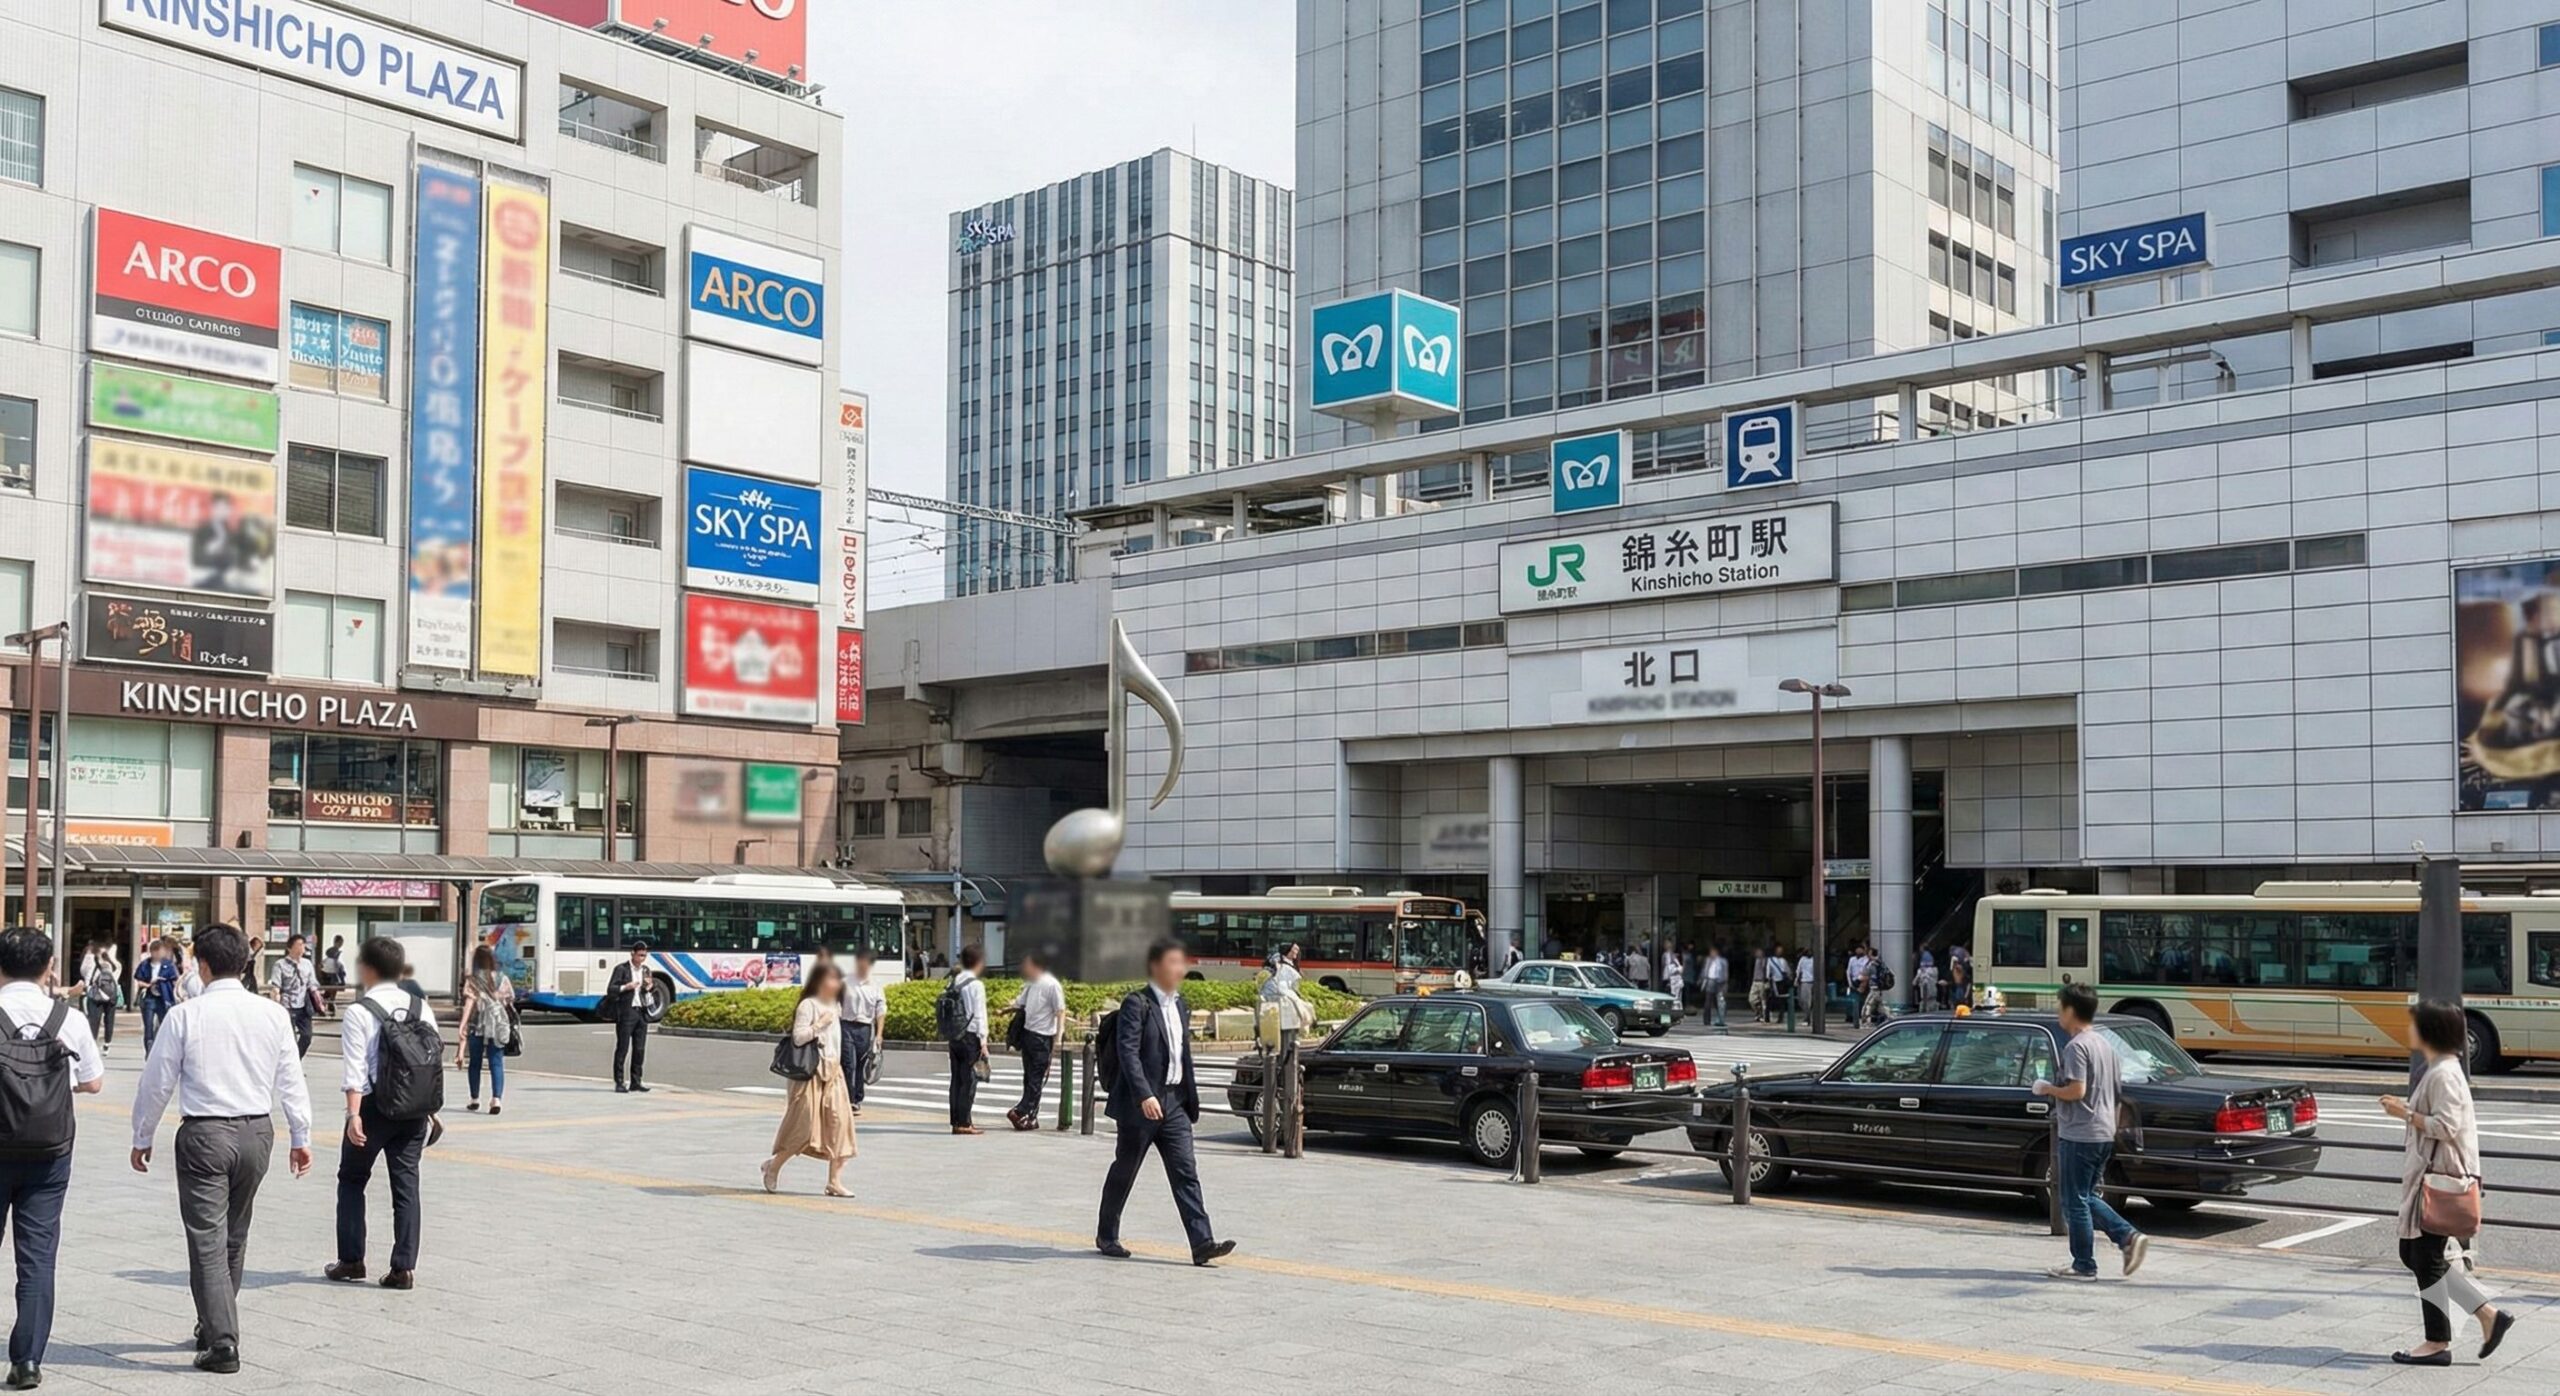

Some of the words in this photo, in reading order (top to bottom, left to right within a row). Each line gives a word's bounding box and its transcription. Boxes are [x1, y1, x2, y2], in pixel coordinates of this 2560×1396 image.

[379, 42, 505, 120] PLAZA
[987, 222, 1017, 244] SPA
[2070, 238, 2131, 275] SKY
[2138, 226, 2198, 262] SPA
[122, 240, 257, 299] ARCO
[700, 266, 817, 328] ARCO
[695, 503, 754, 540] SKY
[759, 513, 813, 551] SPA
[1621, 516, 1789, 574] 錦糸町駅
[1527, 543, 1586, 587] JR
[1631, 569, 1714, 593] Kinshicho
[1718, 563, 1780, 584] Station
[1623, 649, 1699, 688] 北口
[121, 680, 308, 722] KINSHICHO
[319, 695, 418, 730] PLAZA
